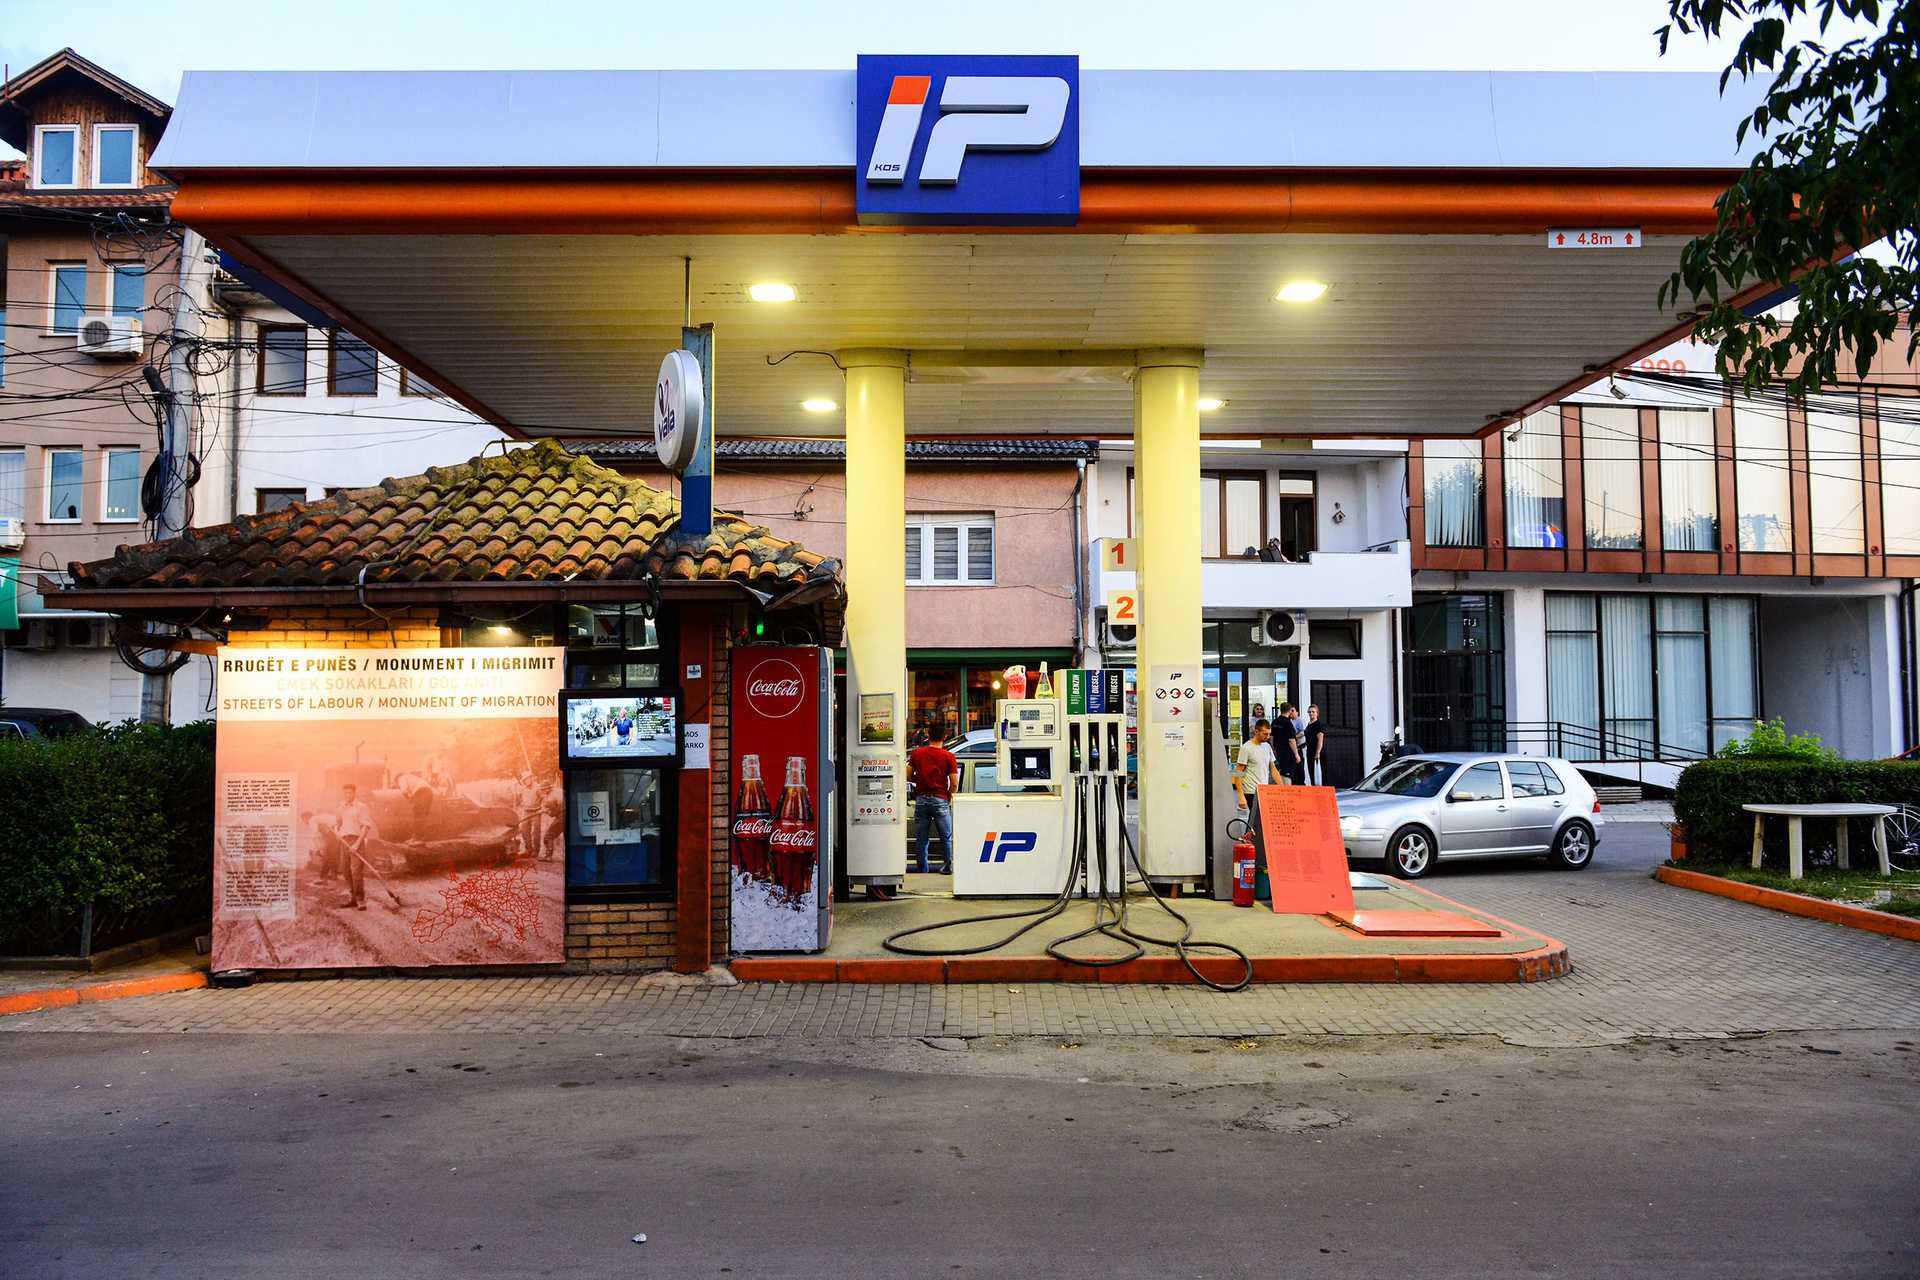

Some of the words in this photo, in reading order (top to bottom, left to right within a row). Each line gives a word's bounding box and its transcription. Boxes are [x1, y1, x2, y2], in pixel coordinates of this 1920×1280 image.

[1577, 232, 1613, 245] 4.8m
[658, 402, 675, 441] vala
[1111, 543, 1124, 564] 1
[1116, 596, 1134, 619] 2
[223, 656, 284, 672] RRUGËT
[291, 659, 299, 671] E
[306, 656, 357, 671] PUNËS
[376, 657, 464, 671] MONUMENT
[471, 658, 475, 670] I
[482, 657, 556, 670] MIGRIMIT
[750, 679, 801, 696] Coca-Cola
[1091, 675, 1099, 694] DIESEL
[1110, 674, 1118, 694] DIESEL
[223, 698, 282, 710] STREETS
[287, 697, 304, 709] OF
[309, 697, 364, 709] LABOUR
[378, 696, 456, 708] MONUMENT
[460, 696, 478, 707] OF
[482, 695, 556, 707] MIGRATION
[769, 829, 816, 846] Coca-Cola
